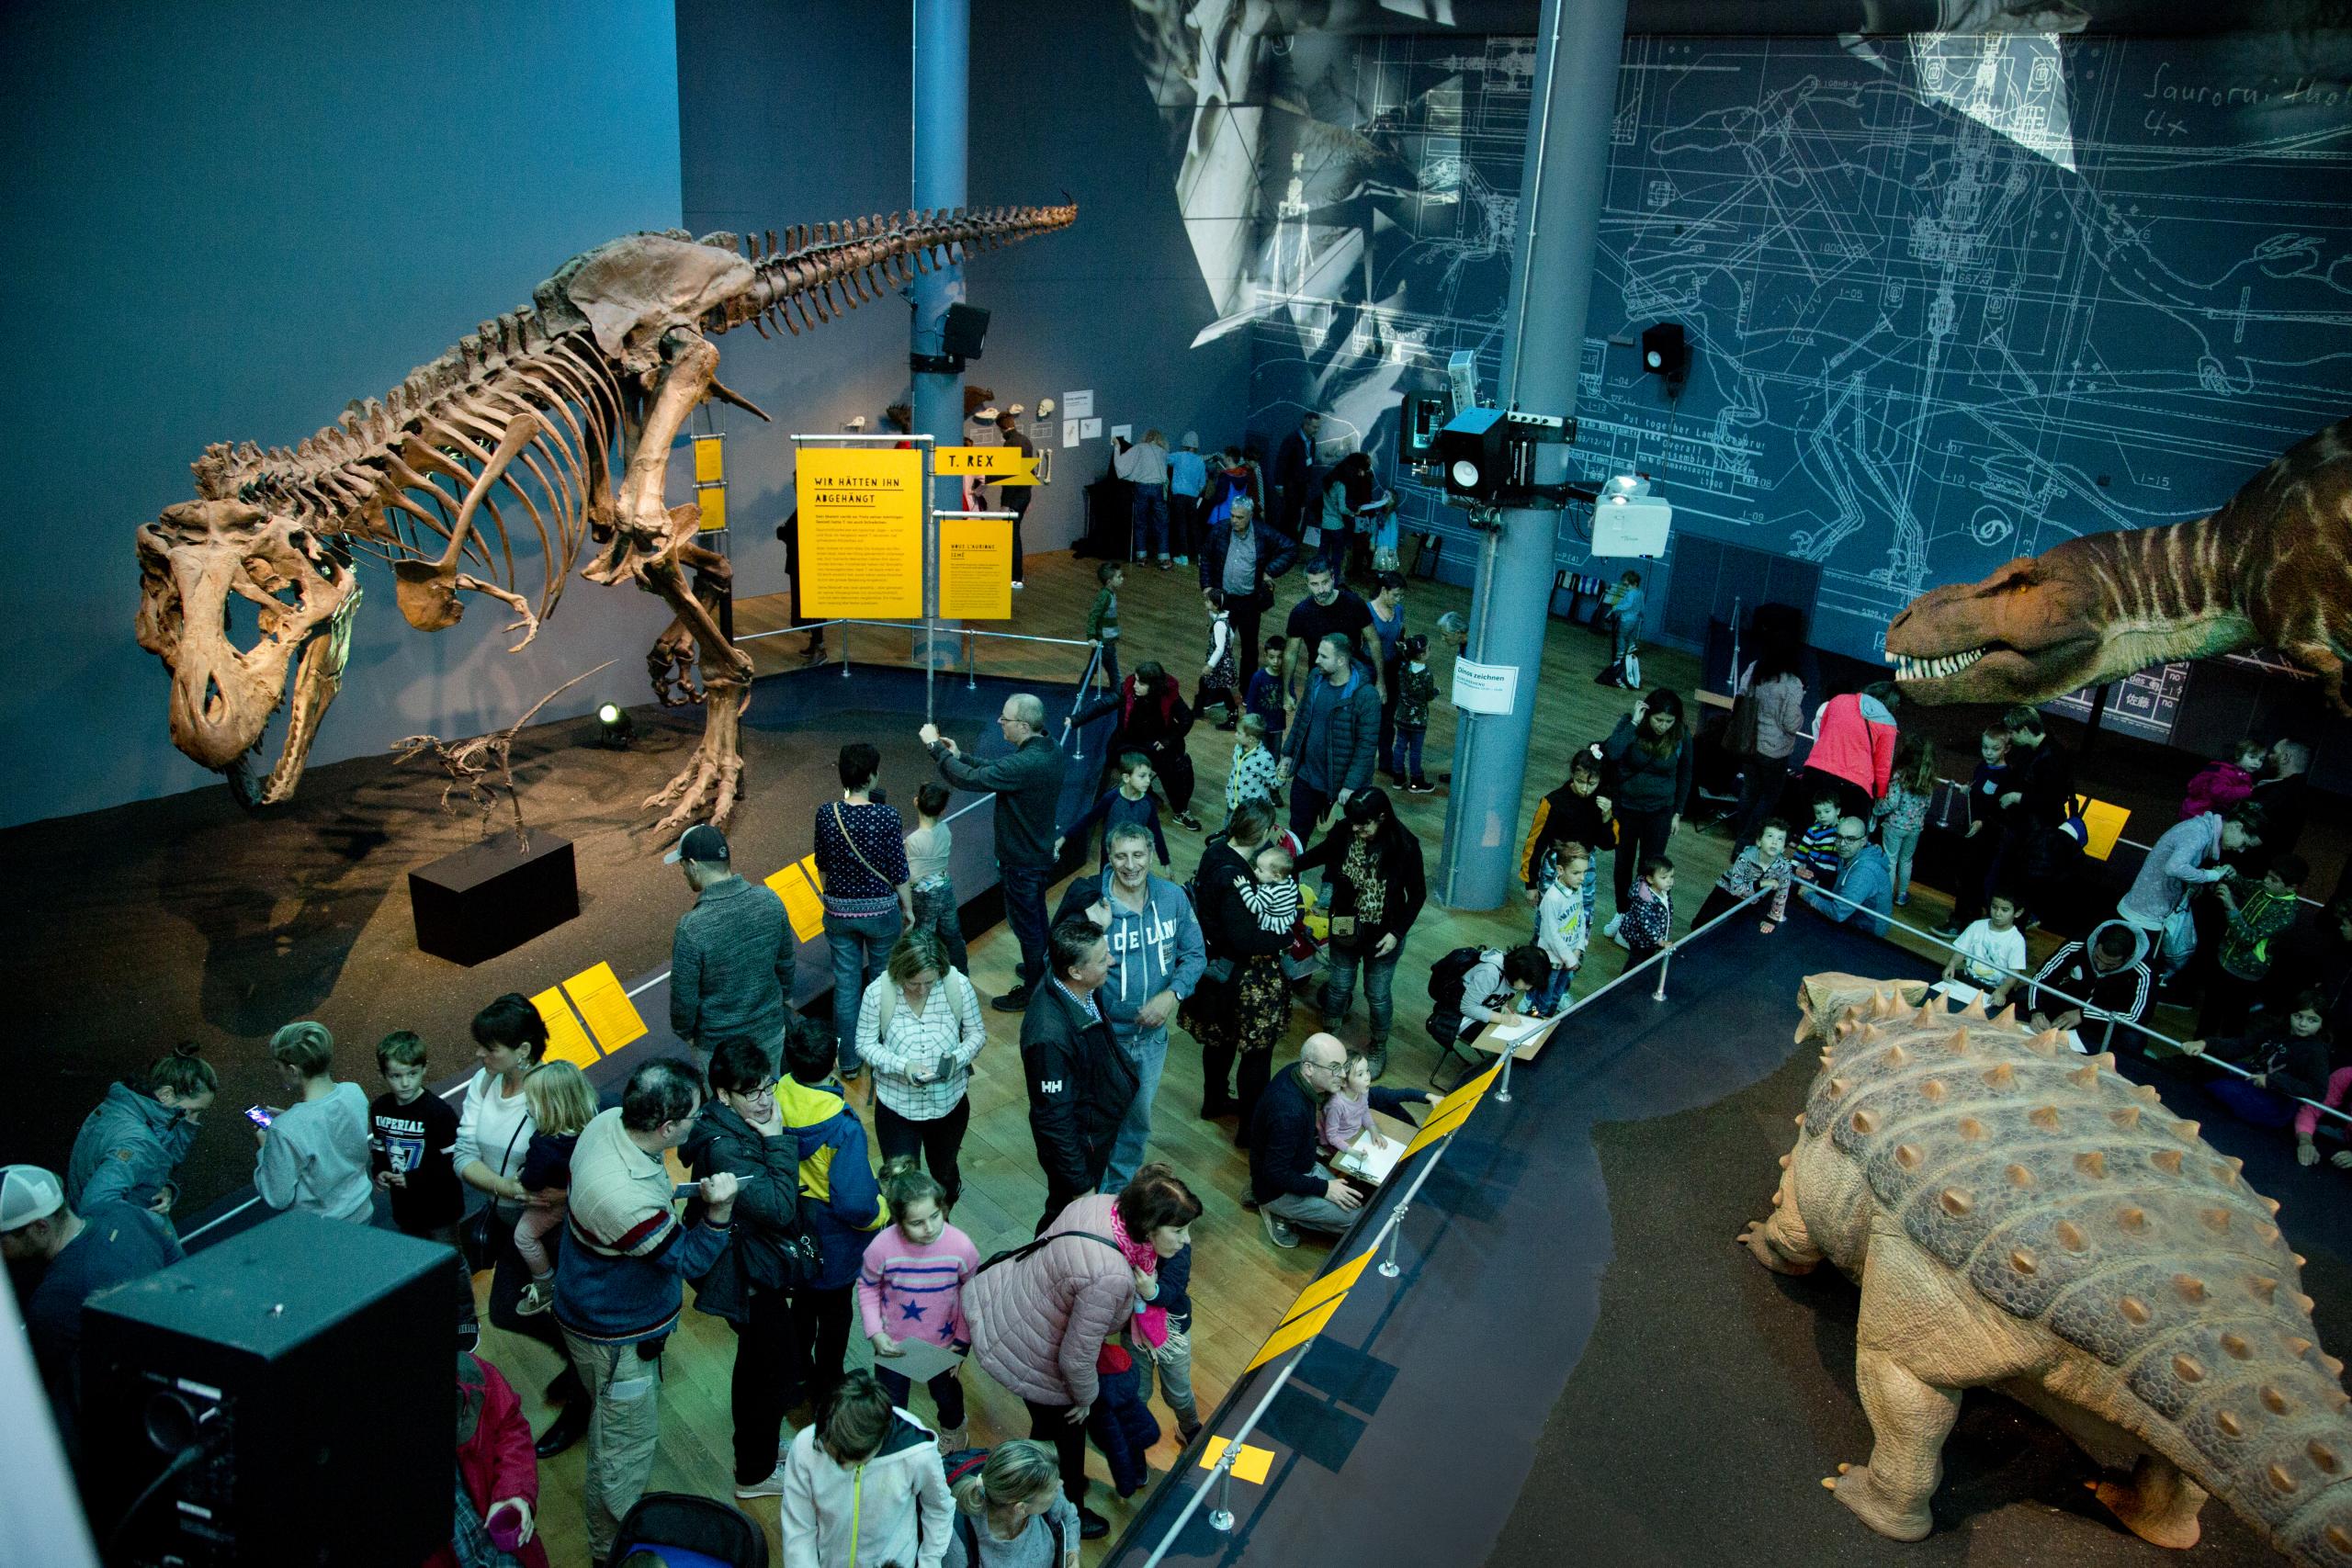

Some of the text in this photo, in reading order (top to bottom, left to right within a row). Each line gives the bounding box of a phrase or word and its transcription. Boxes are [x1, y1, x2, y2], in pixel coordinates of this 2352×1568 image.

[949, 455, 993, 467] T. REX
[814, 475, 899, 487] WIR HÄTTEN IHN
[2141, 472, 2170, 487] 1-15
[815, 491, 875, 503] ABGEHÄNGT
[1457, 667, 1472, 678] Dinos
[1474, 673, 1505, 682] zeichnen
[1041, 1079, 1063, 1093] HH
[375, 1115, 426, 1134] IMPERIAL
